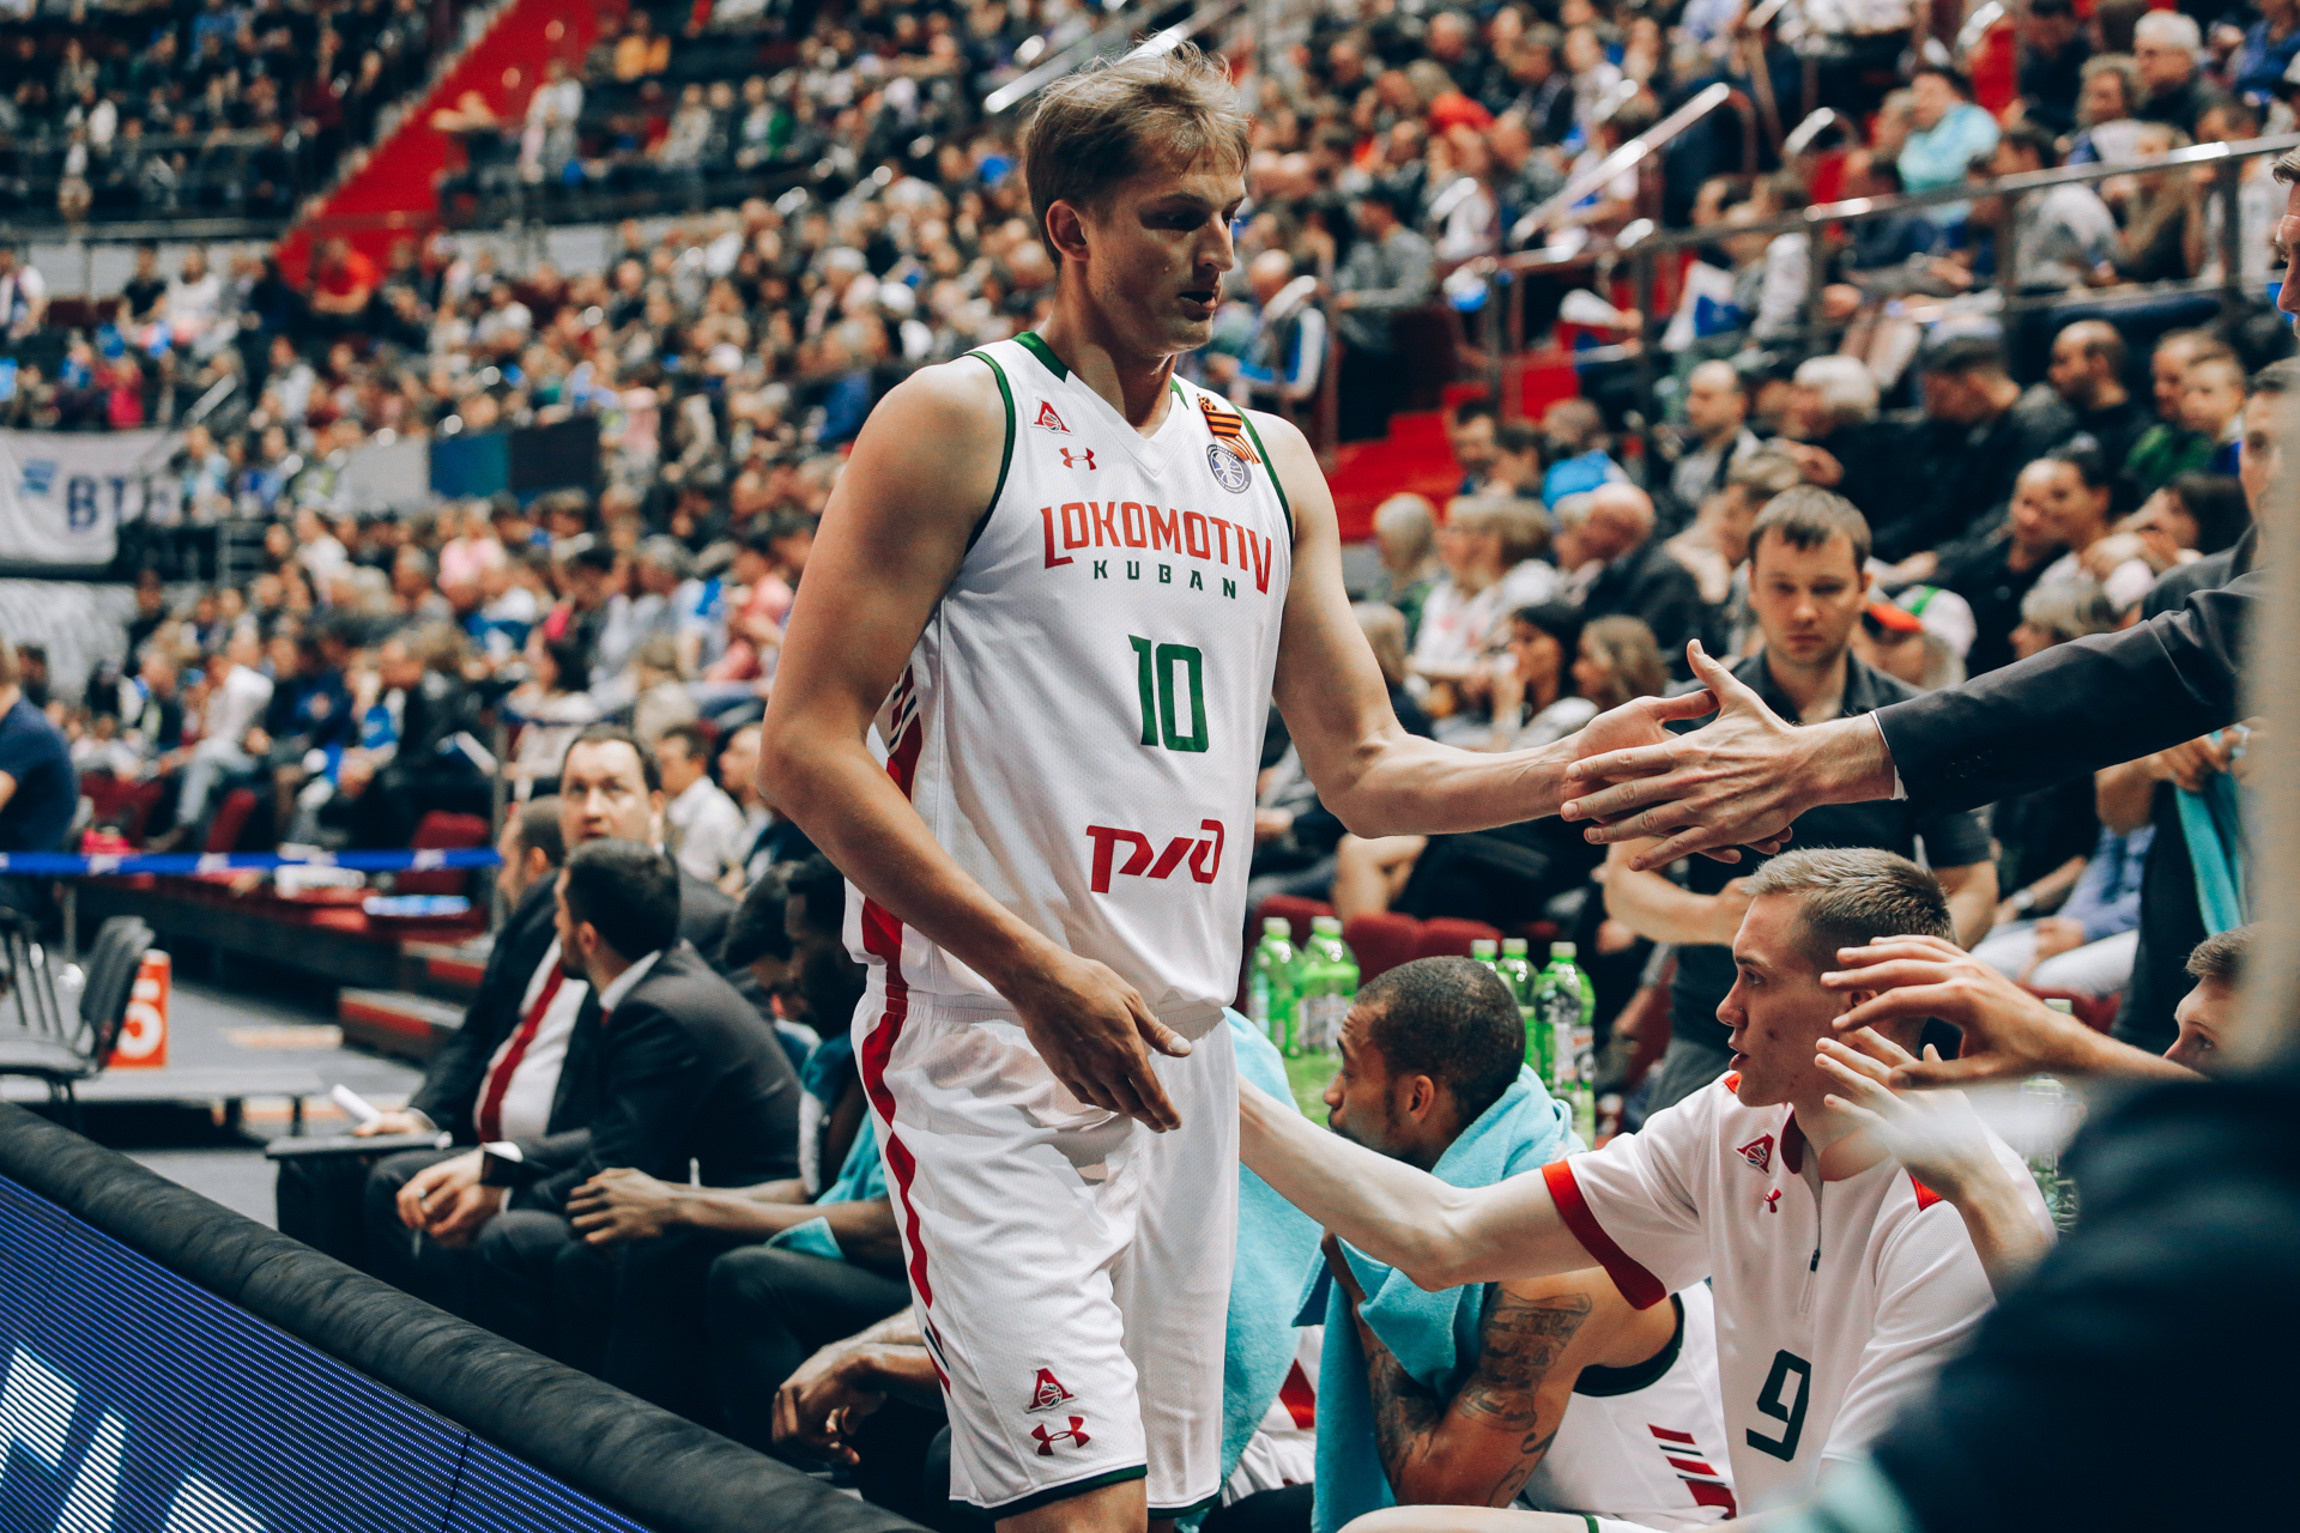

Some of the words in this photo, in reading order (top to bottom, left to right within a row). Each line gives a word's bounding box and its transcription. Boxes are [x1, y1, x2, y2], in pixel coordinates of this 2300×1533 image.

[1040, 501, 1272, 596] LOKOMOTIV
[1093, 559, 1237, 600] KUBAN
[1127, 633, 1210, 754] 10
[1745, 1348, 1812, 1463] 9
